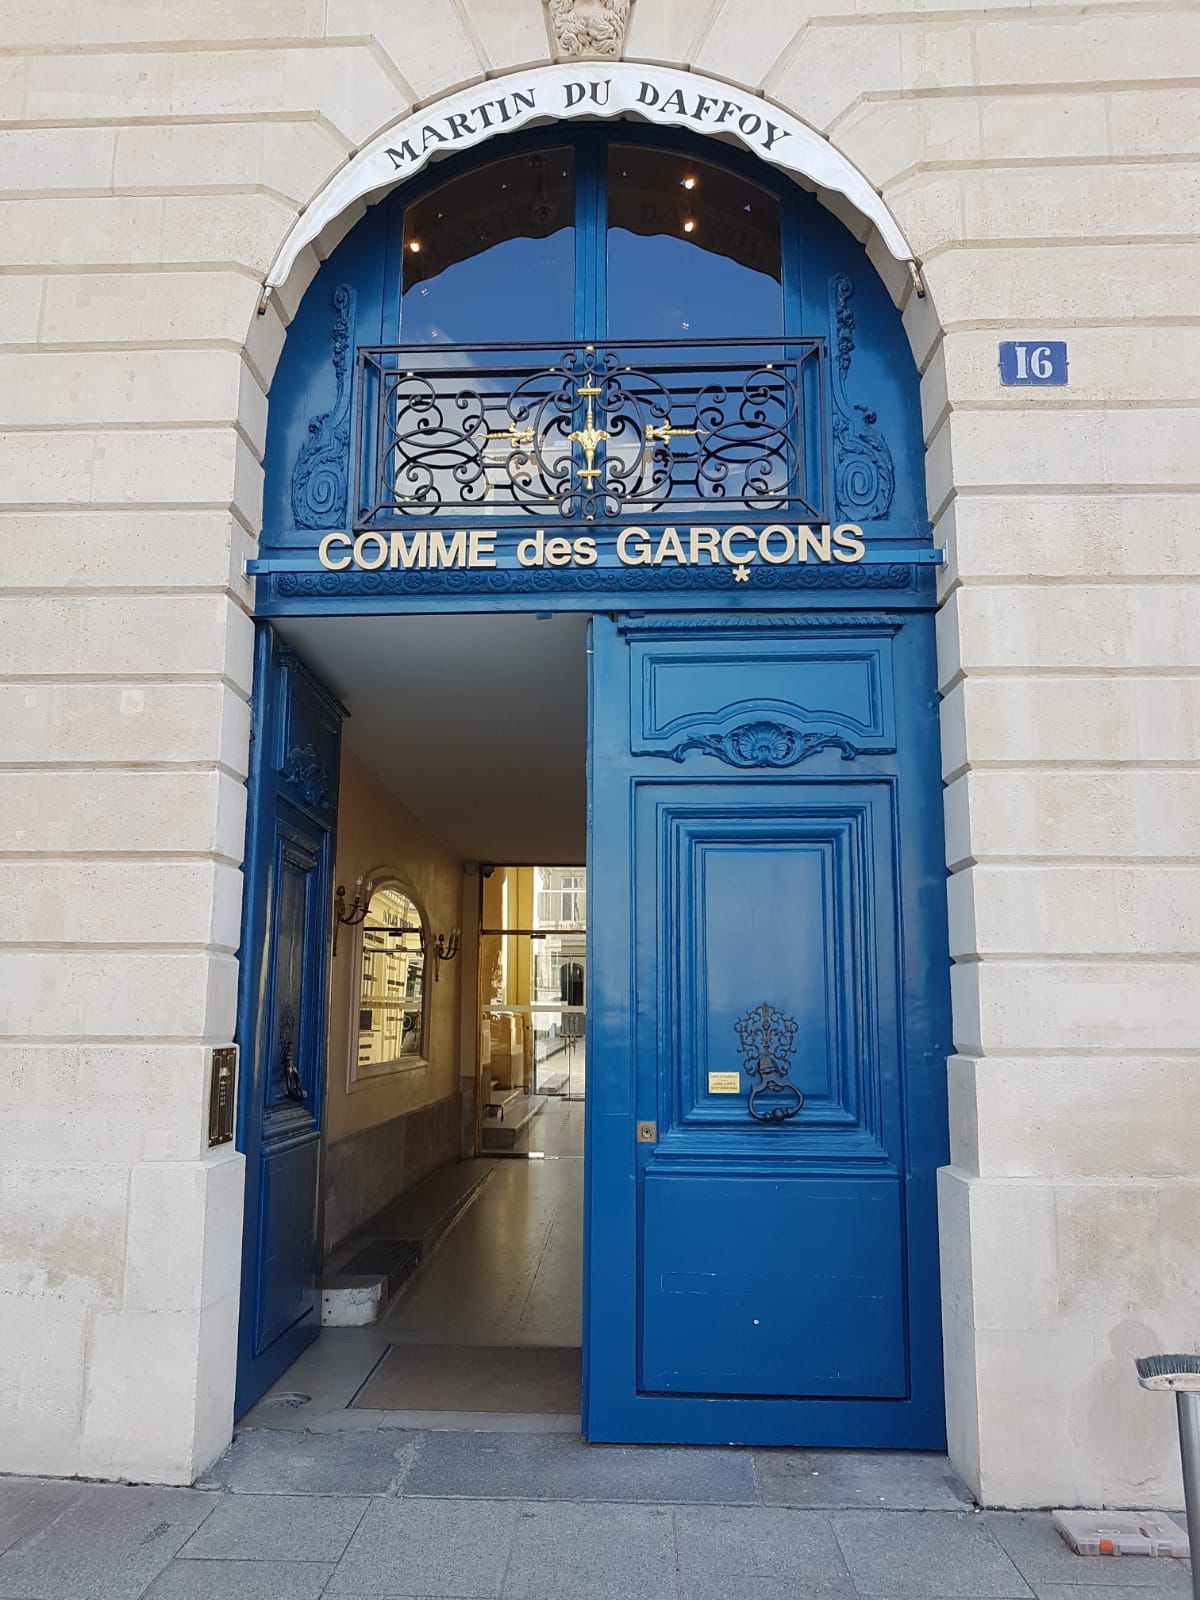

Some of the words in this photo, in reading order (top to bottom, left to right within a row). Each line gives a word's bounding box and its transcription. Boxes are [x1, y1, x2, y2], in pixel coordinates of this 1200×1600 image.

[384, 86, 536, 171] MARTIN
[562, 79, 613, 108] DU
[636, 80, 792, 152] DAFFOY
[1015, 346, 1053, 379] 16
[318, 530, 498, 570] COMME
[516, 529, 598, 566] des
